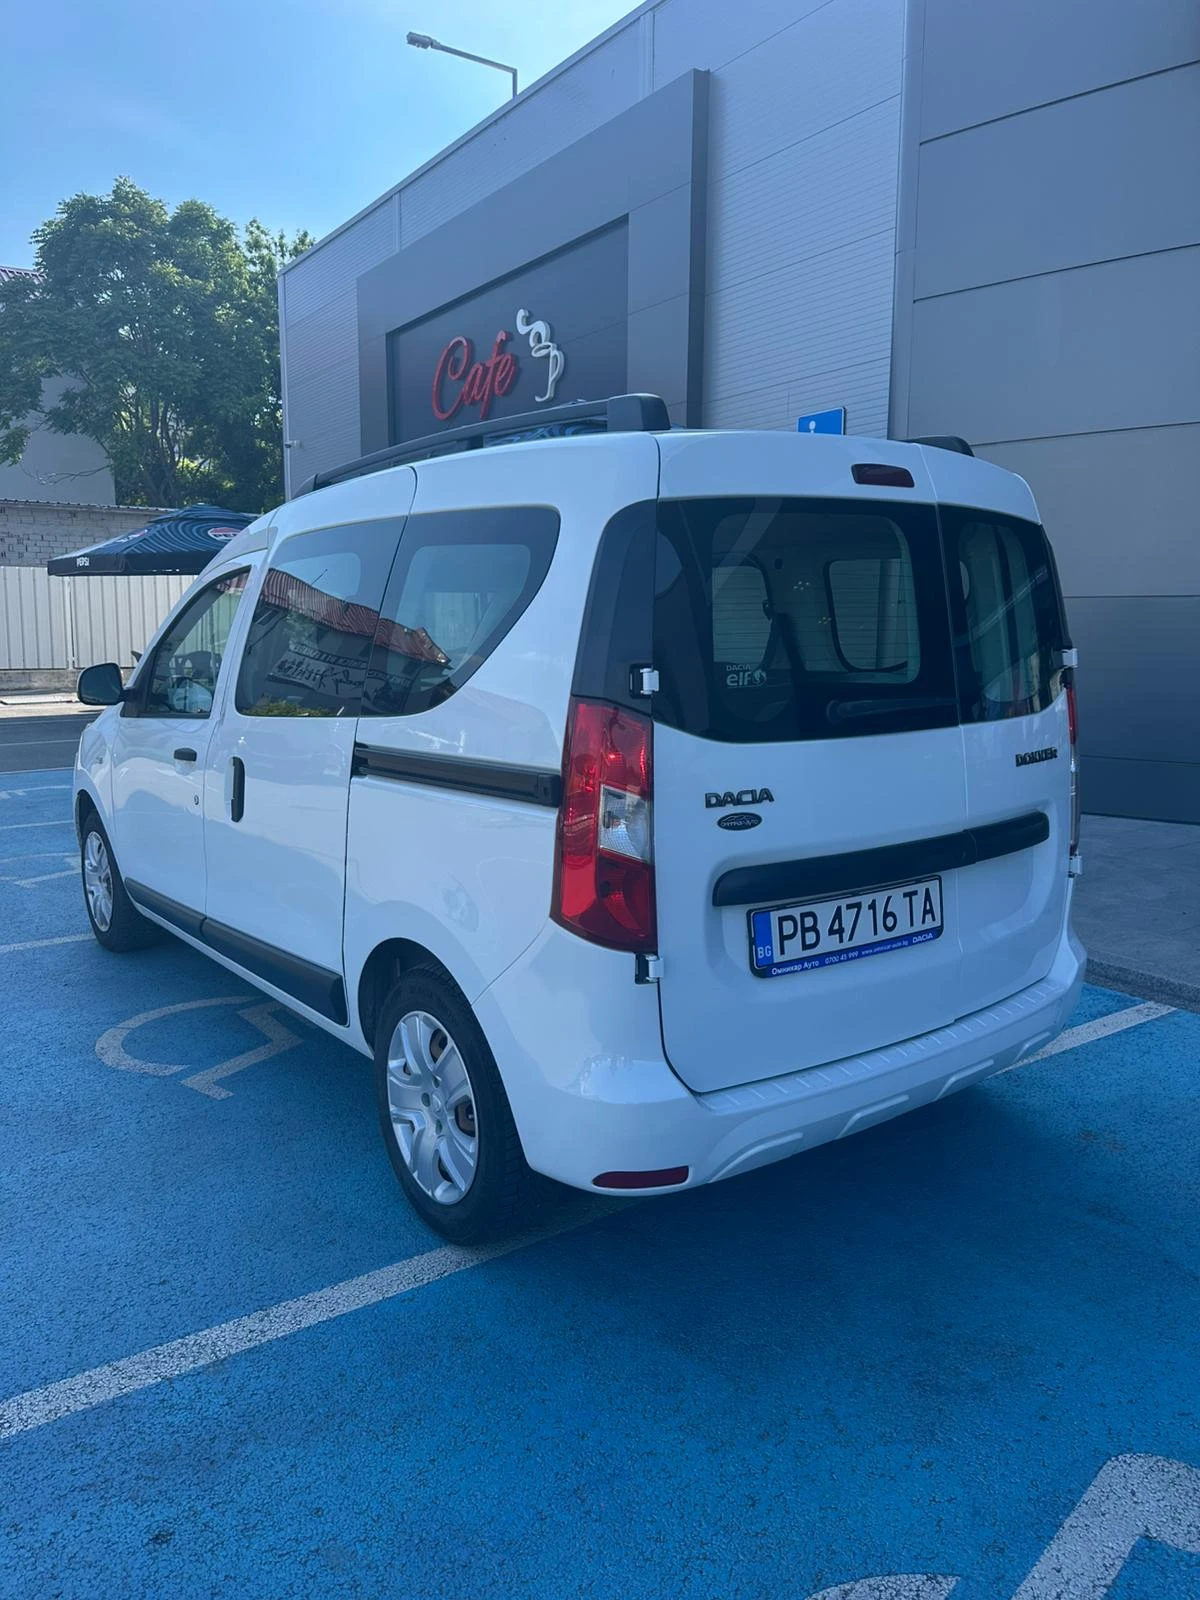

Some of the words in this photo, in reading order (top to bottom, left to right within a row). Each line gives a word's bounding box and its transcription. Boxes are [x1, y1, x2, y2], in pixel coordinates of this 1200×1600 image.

[76, 556, 90, 567] PEPSI
[726, 671, 752, 686] elf
[705, 787, 775, 808] DACIA
[777, 910, 821, 956] PB
[827, 895, 898, 944] 4716
[903, 887, 936, 928] TA
[912, 932, 933, 943] DACIA
[757, 945, 772, 959] BG
